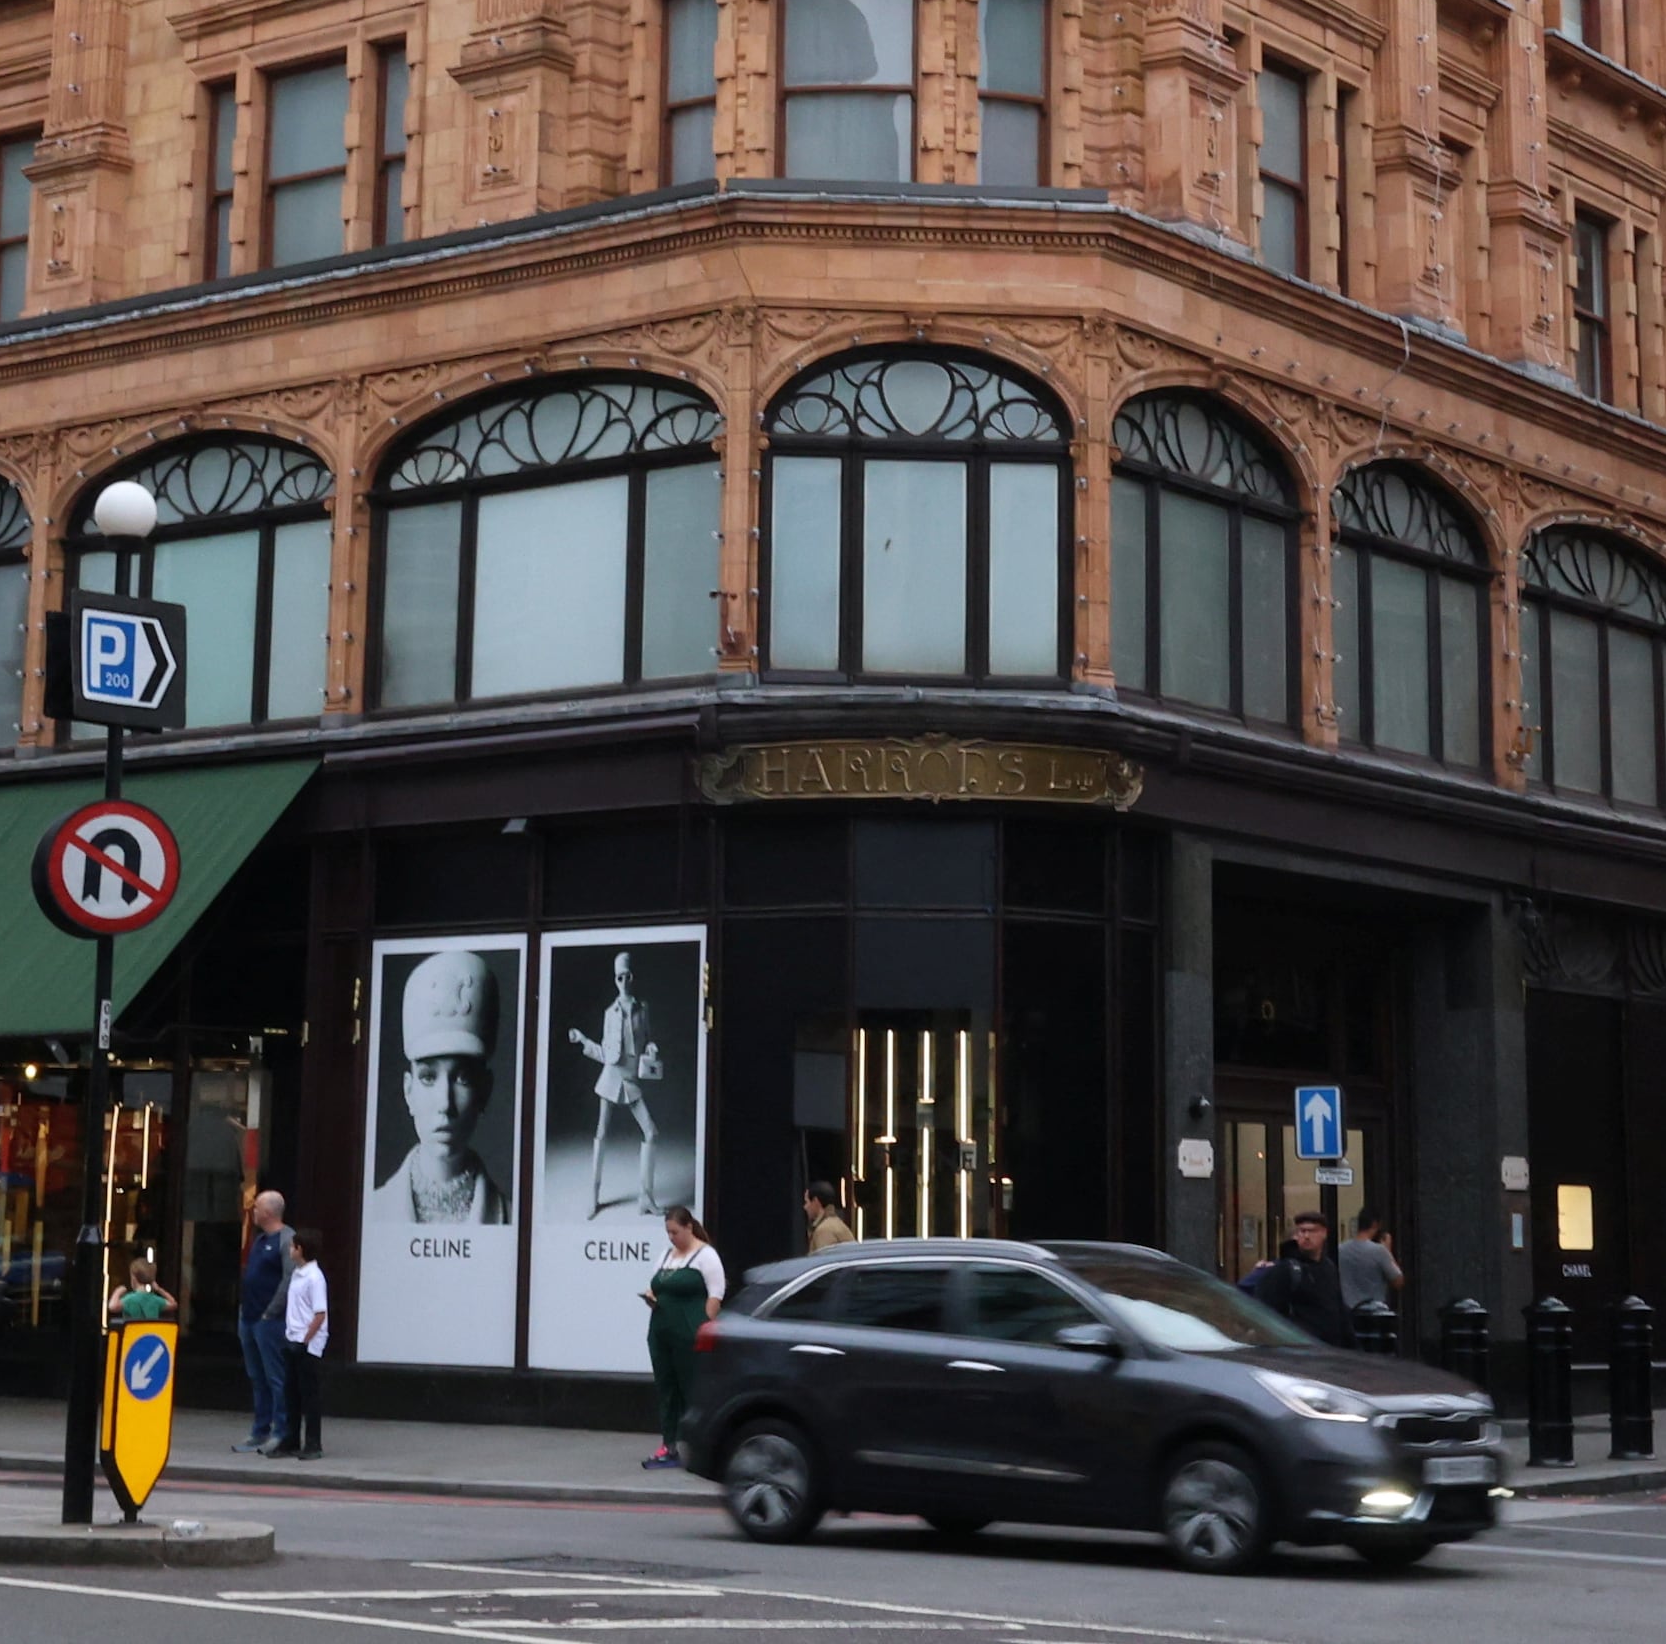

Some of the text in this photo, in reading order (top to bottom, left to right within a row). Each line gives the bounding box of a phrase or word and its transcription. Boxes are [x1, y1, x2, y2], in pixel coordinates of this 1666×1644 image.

[90, 623, 126, 688] P
[105, 672, 130, 689] 200
[757, 748, 1026, 794] HARRODS
[410, 1237, 472, 1258] CELINE
[584, 1240, 651, 1262] CELINE
